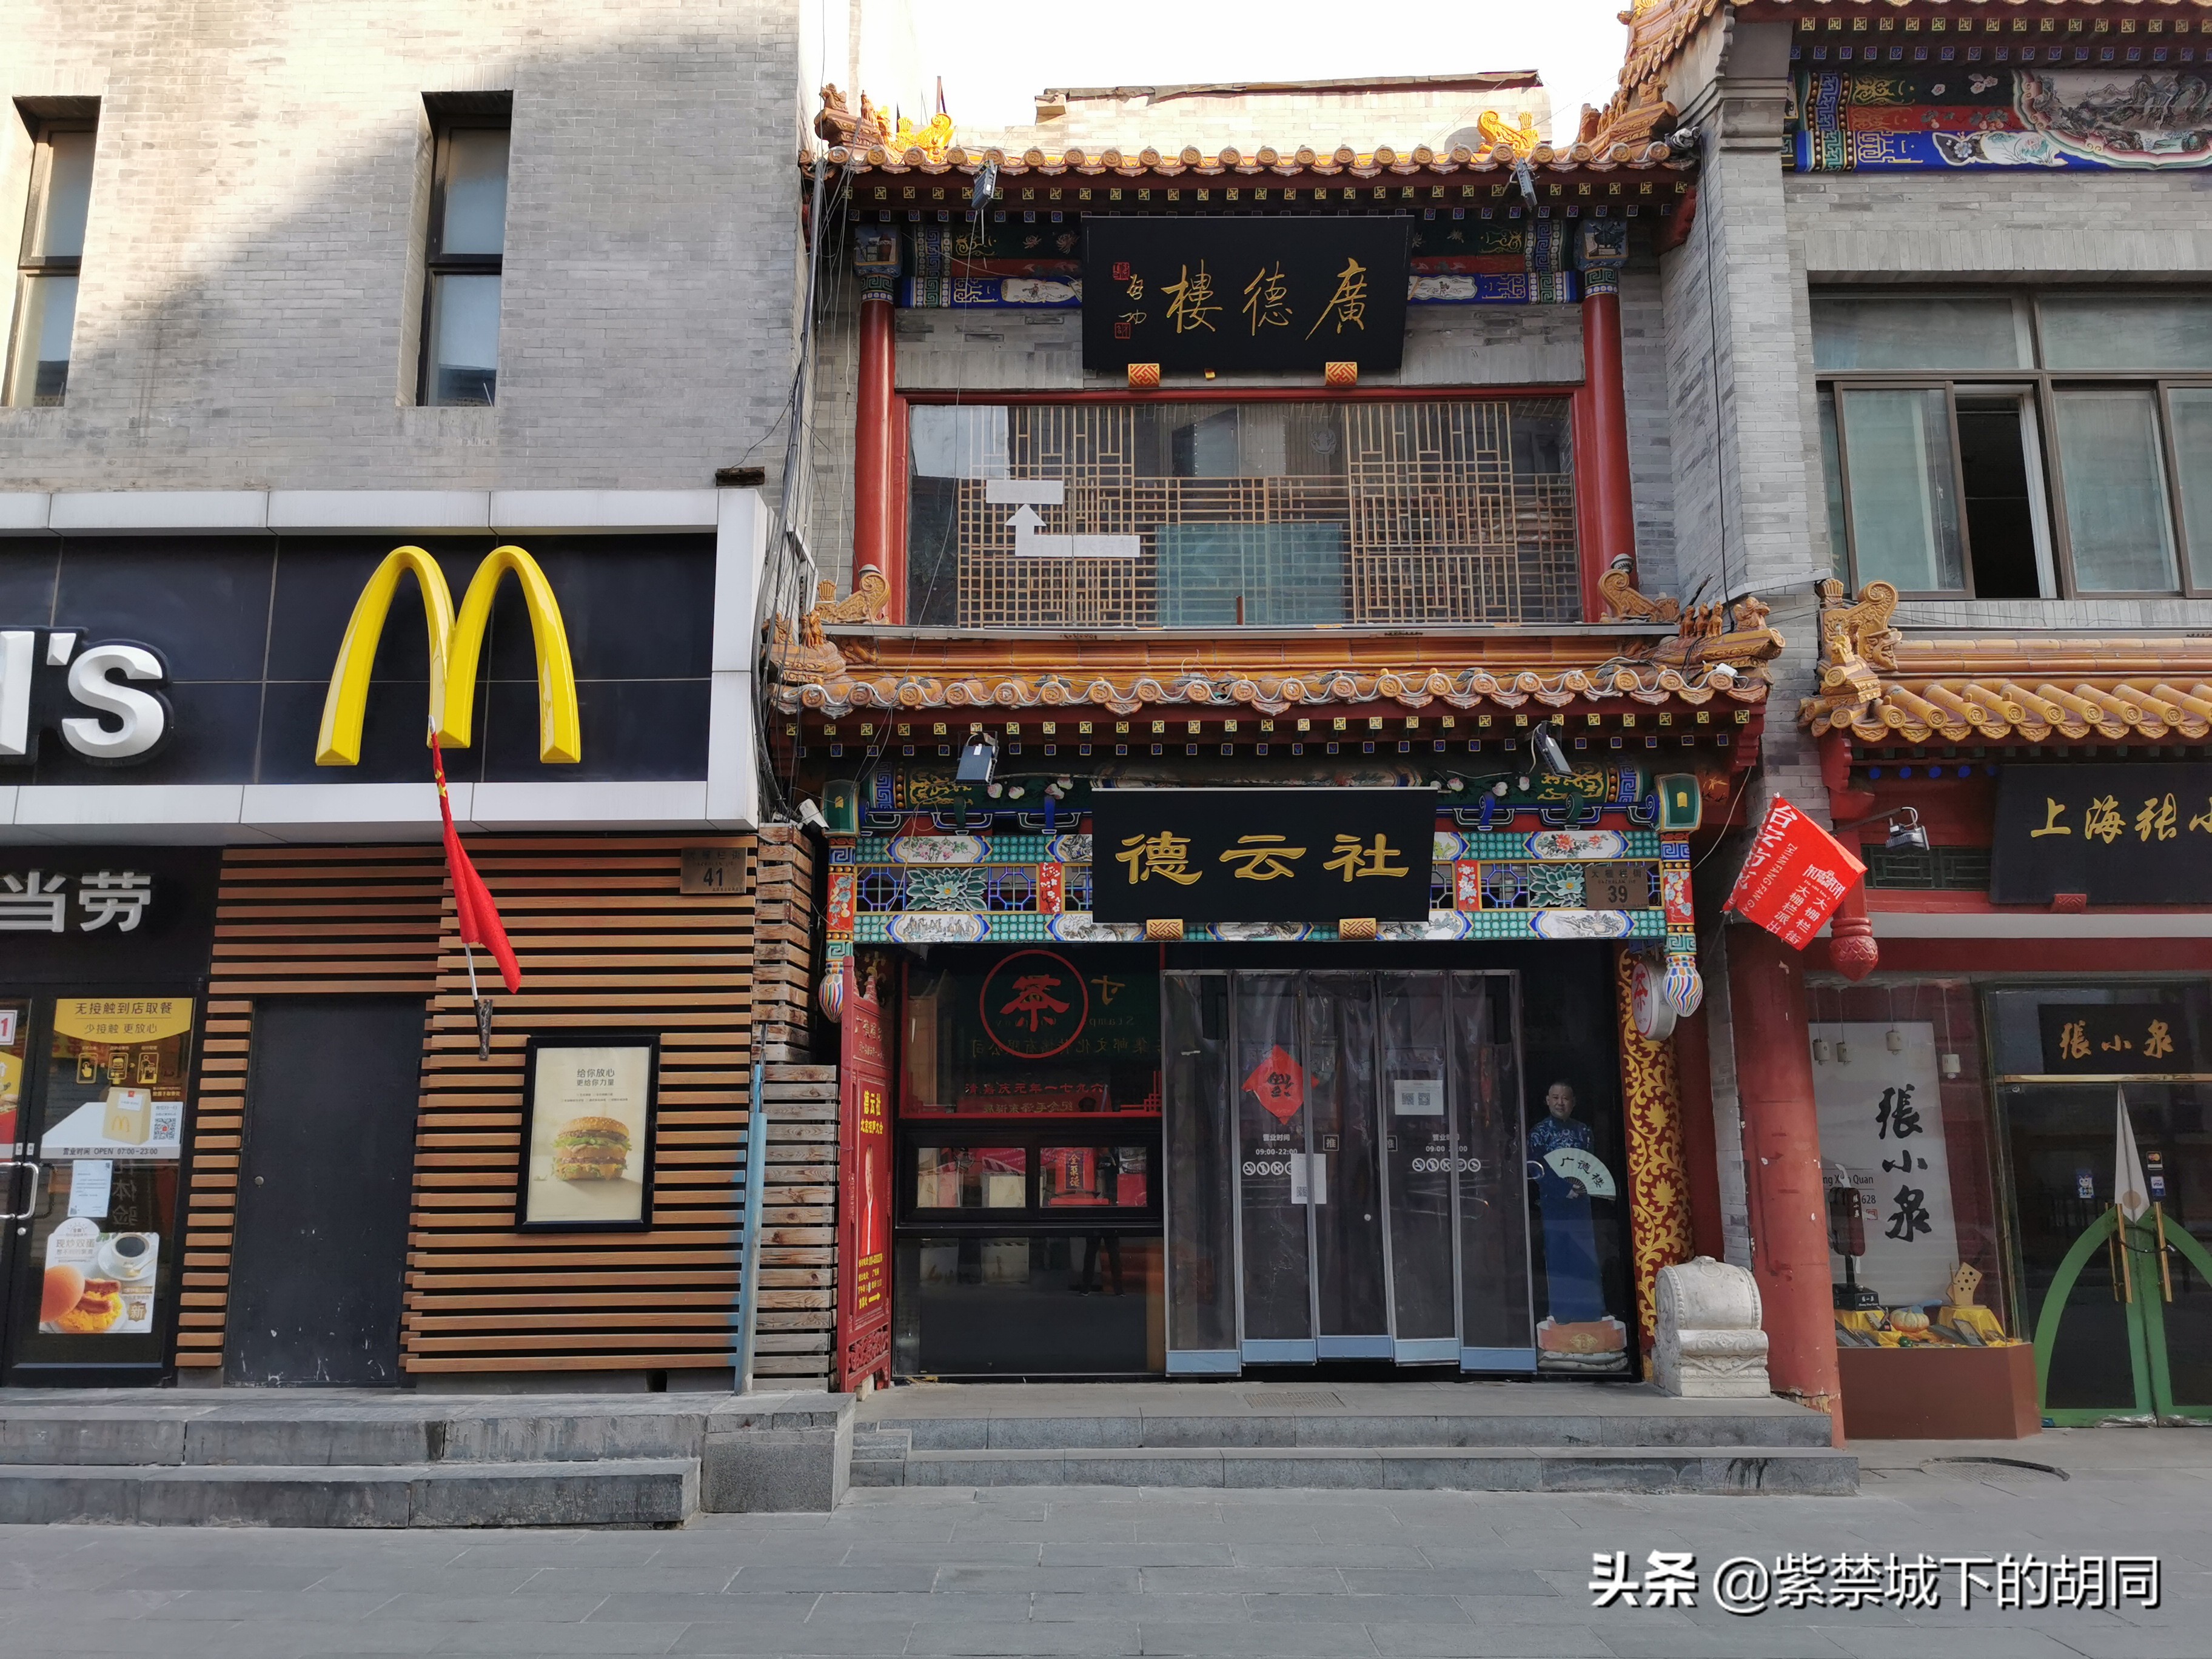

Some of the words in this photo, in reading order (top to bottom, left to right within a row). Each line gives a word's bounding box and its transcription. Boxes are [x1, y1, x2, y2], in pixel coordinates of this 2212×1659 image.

[1115, 831, 1409, 885] 德云社
[703, 867, 723, 886] 41
[1608, 885, 1627, 903] 39
[75, 1002, 173, 1014] 无接触到店取餐
[1000, 974, 1070, 1032] 茶
[84, 1024, 118, 1034] 少接触
[123, 1023, 158, 1034] 更放心
[577, 1068, 615, 1078] 给你放心
[863, 1090, 881, 1116] 德云社
[1262, 1133, 1290, 1142] 营业时间
[1853, 1175, 1874, 1184] Quan
[130, 1305, 144, 1318] 新
